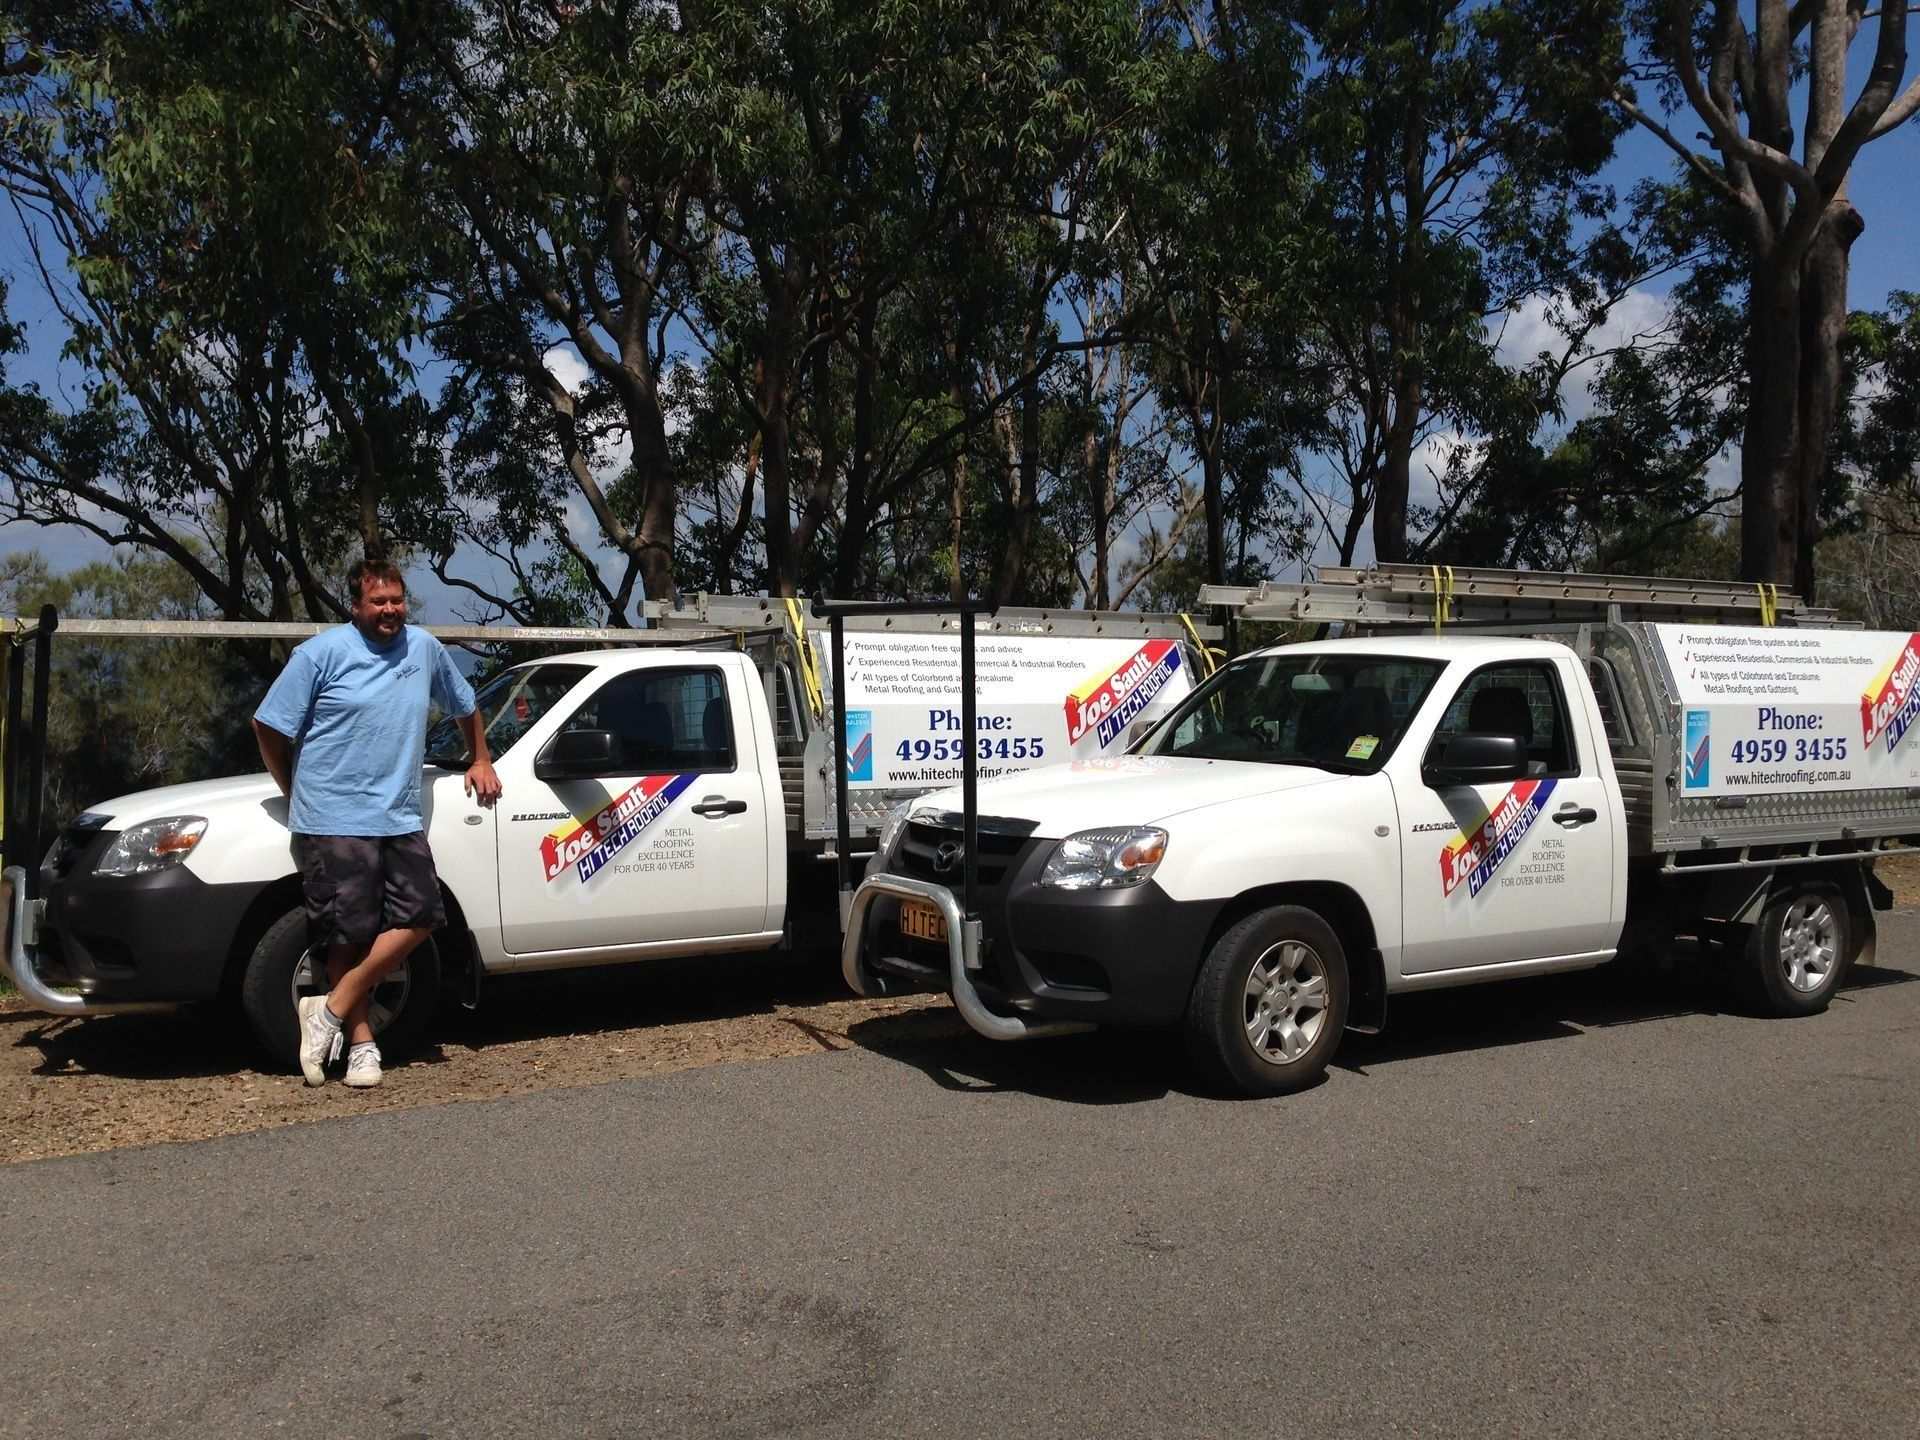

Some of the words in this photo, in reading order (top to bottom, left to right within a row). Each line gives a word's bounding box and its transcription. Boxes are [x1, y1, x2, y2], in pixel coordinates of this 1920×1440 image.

[855, 643, 886, 652] Prompt
[889, 643, 929, 653] obligation
[931, 644, 948, 652] free
[951, 645, 977, 653] qus
[1687, 636, 1714, 646] Prompt
[1715, 636, 1748, 647] obligation
[1748, 637, 1762, 646] free
[1764, 638, 1786, 648] quotes
[1787, 639, 1799, 647] and
[1801, 639, 1820, 647] advice
[859, 658, 910, 667] Experienced
[975, 660, 1009, 668] mmercial
[1020, 660, 1055, 668] Industrial
[1693, 653, 1735, 663] Experienced
[1776, 655, 1813, 664] Commercial
[1814, 656, 1819, 664] &
[1820, 656, 1848, 664] Industrial
[1849, 656, 1873, 665] Roofers
[862, 674, 873, 682] All
[875, 674, 898, 683] types
[901, 674, 909, 682] of
[911, 674, 953, 682] Colorbond
[1700, 671, 1709, 680] All
[1710, 672, 1729, 681] types
[1731, 671, 1737, 680] of
[1740, 671, 1772, 680] Colorbond
[1774, 672, 1786, 680] and
[865, 685, 889, 693] Metal
[892, 685, 925, 695] Roofing
[1072, 692, 1112, 739] Joe
[1110, 652, 1152, 700] Sault
[1704, 685, 1725, 693] Metal
[1726, 685, 1753, 695] Roofing
[1768, 685, 1798, 695] Guttering
[1866, 692, 1897, 742] Joe
[1892, 647, 1920, 699] Sault
[1099, 721, 1113, 746] HI
[1112, 692, 1143, 730] TECH
[1139, 660, 1172, 702] ROOFING
[929, 709, 1012, 730] Phne:
[1758, 707, 1822, 730] Phone:
[1887, 721, 1898, 751] HI
[1897, 690, 1920, 732] TECH
[896, 739, 964, 760] 4959
[977, 737, 1044, 759] 3455
[1731, 739, 1787, 763] 4959
[1795, 738, 1847, 762] 3455
[1726, 769, 1851, 785] www.hitechroofing.com.au
[549, 830, 593, 876] Joe
[597, 786, 648, 836] Sault
[579, 857, 595, 880] HI
[593, 829, 629, 864] TECH
[627, 792, 669, 836] ROOFING
[665, 828, 693, 837] METAL
[653, 839, 694, 848] ROOFING
[1446, 840, 1481, 891] Joe
[1483, 793, 1521, 846] Sault
[1470, 870, 1482, 894] HI
[1481, 840, 1509, 876] TECH
[1507, 800, 1539, 847] ROOFING
[1542, 839, 1564, 848] METAL
[638, 849, 694, 861] EXCELLENCE
[1533, 851, 1565, 861] ROOFING
[614, 865, 631, 873] FOR
[633, 863, 655, 872] OVER
[657, 863, 667, 871] 40
[669, 861, 694, 870] YEARS
[1521, 863, 1565, 873] EXCELLENCE
[1501, 878, 1514, 887] FOR
[1516, 876, 1533, 886] OVER
[1535, 876, 1543, 884] 40
[1544, 874, 1565, 884] YEARS
